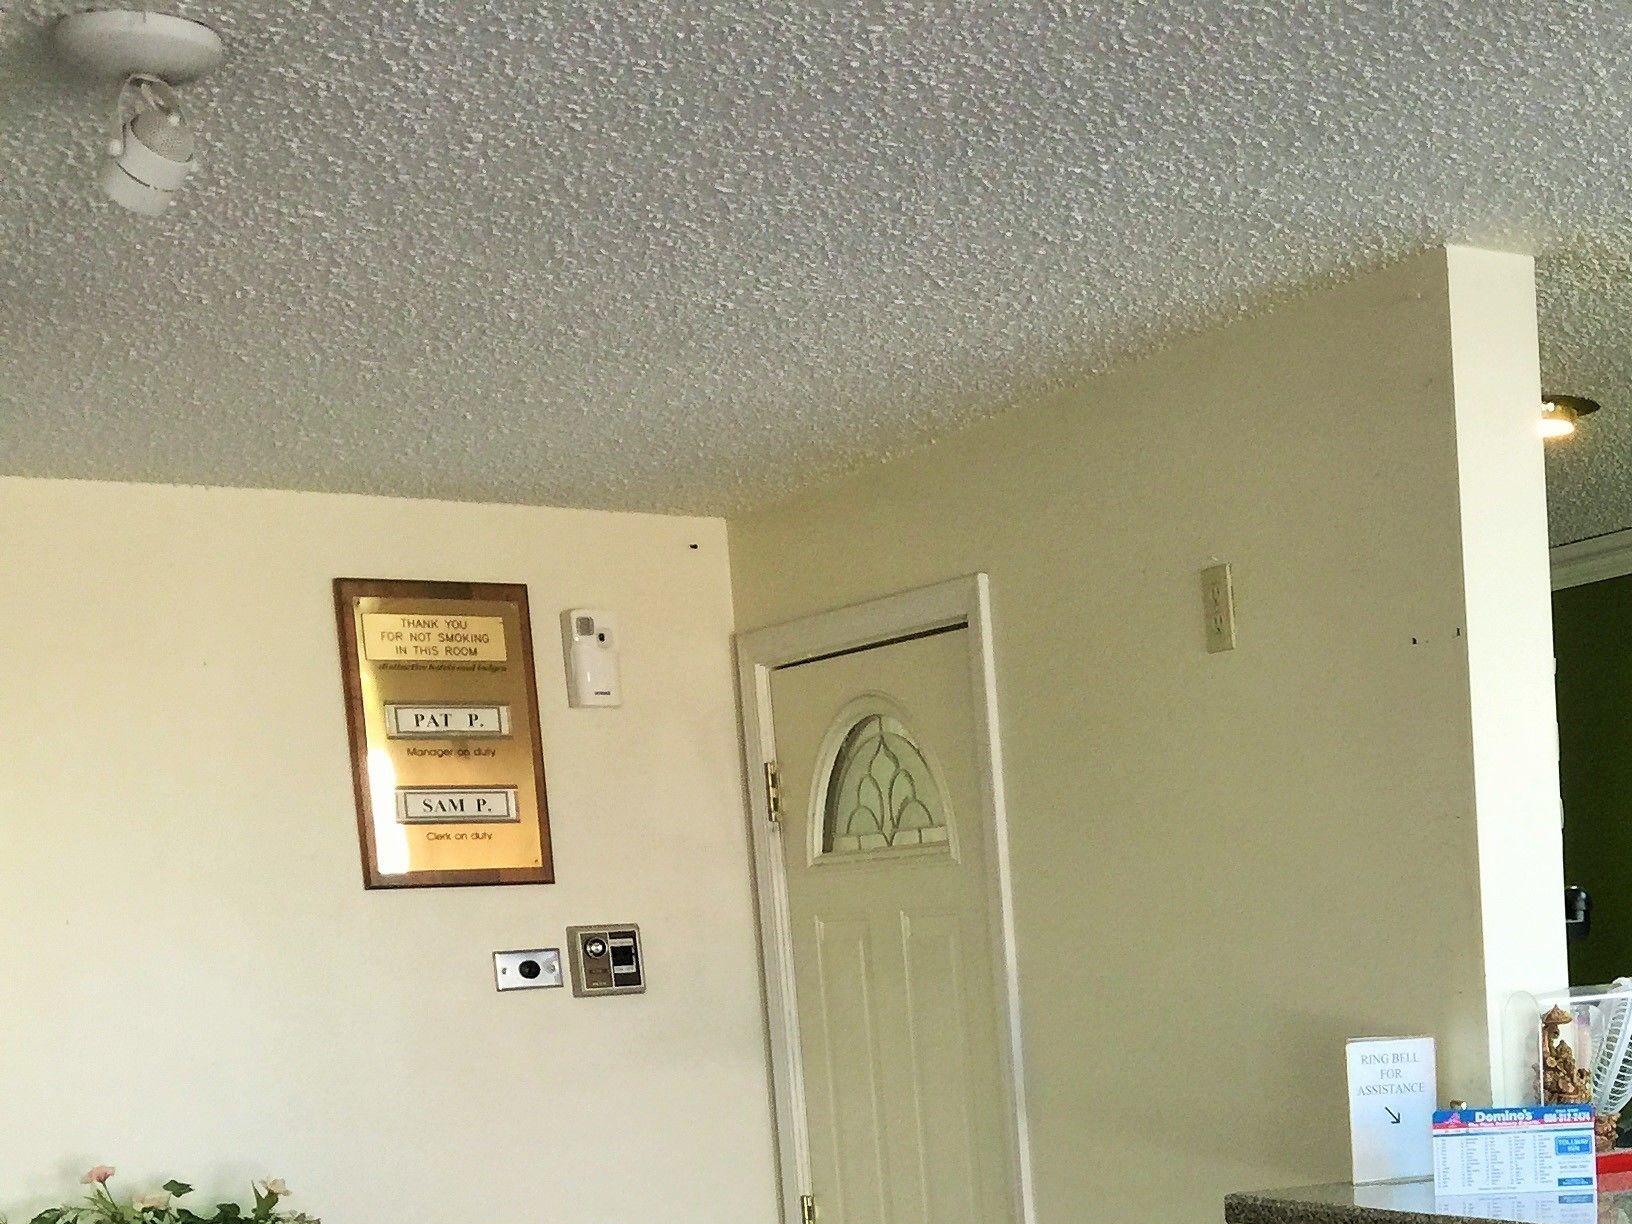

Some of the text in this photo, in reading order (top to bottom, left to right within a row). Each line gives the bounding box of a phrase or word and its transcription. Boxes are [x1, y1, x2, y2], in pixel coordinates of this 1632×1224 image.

[401, 618, 468, 630] THANK YOU
[380, 631, 490, 644] FOR NOT SMOKING
[395, 645, 478, 656] IN THIS ROOM
[413, 713, 485, 728] PAT P.
[406, 747, 496, 759] Manager on duty
[422, 798, 492, 813] SAM P.
[426, 831, 493, 841] Clerk on duty
[1360, 1052, 1420, 1065] RING BELL
[1379, 1068, 1403, 1079] FOR
[1357, 1082, 1425, 1096] ASSISTANCE
[1474, 1109, 1533, 1123] Domino's
